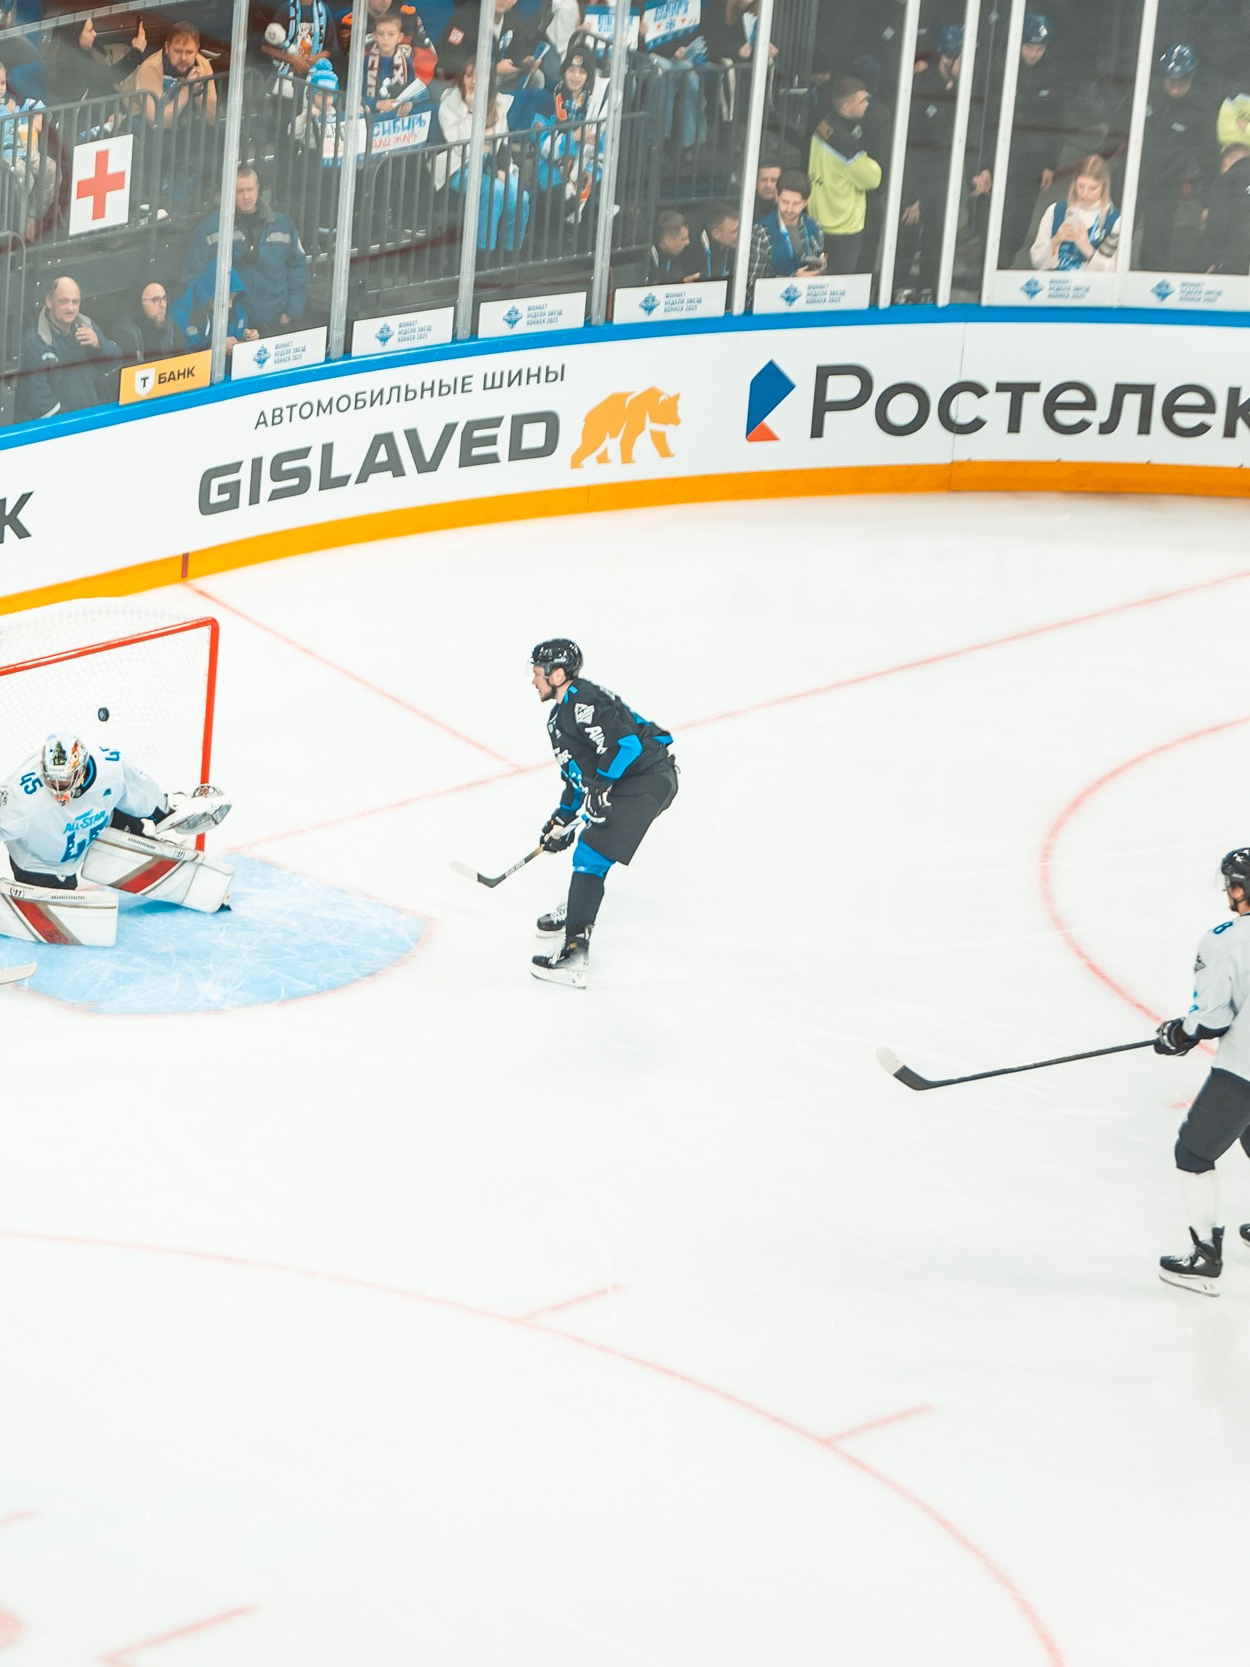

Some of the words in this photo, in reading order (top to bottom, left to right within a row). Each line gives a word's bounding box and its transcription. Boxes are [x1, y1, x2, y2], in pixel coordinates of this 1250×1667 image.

[140, 376, 149, 388] Т
[157, 366, 196, 385] БАНК
[253, 375, 474, 431] АВТОМОБИЛЬНЫЕ
[482, 363, 566, 391] ШИНЫ
[198, 409, 561, 516] GISLAVED
[19, 771, 44, 796] 45
